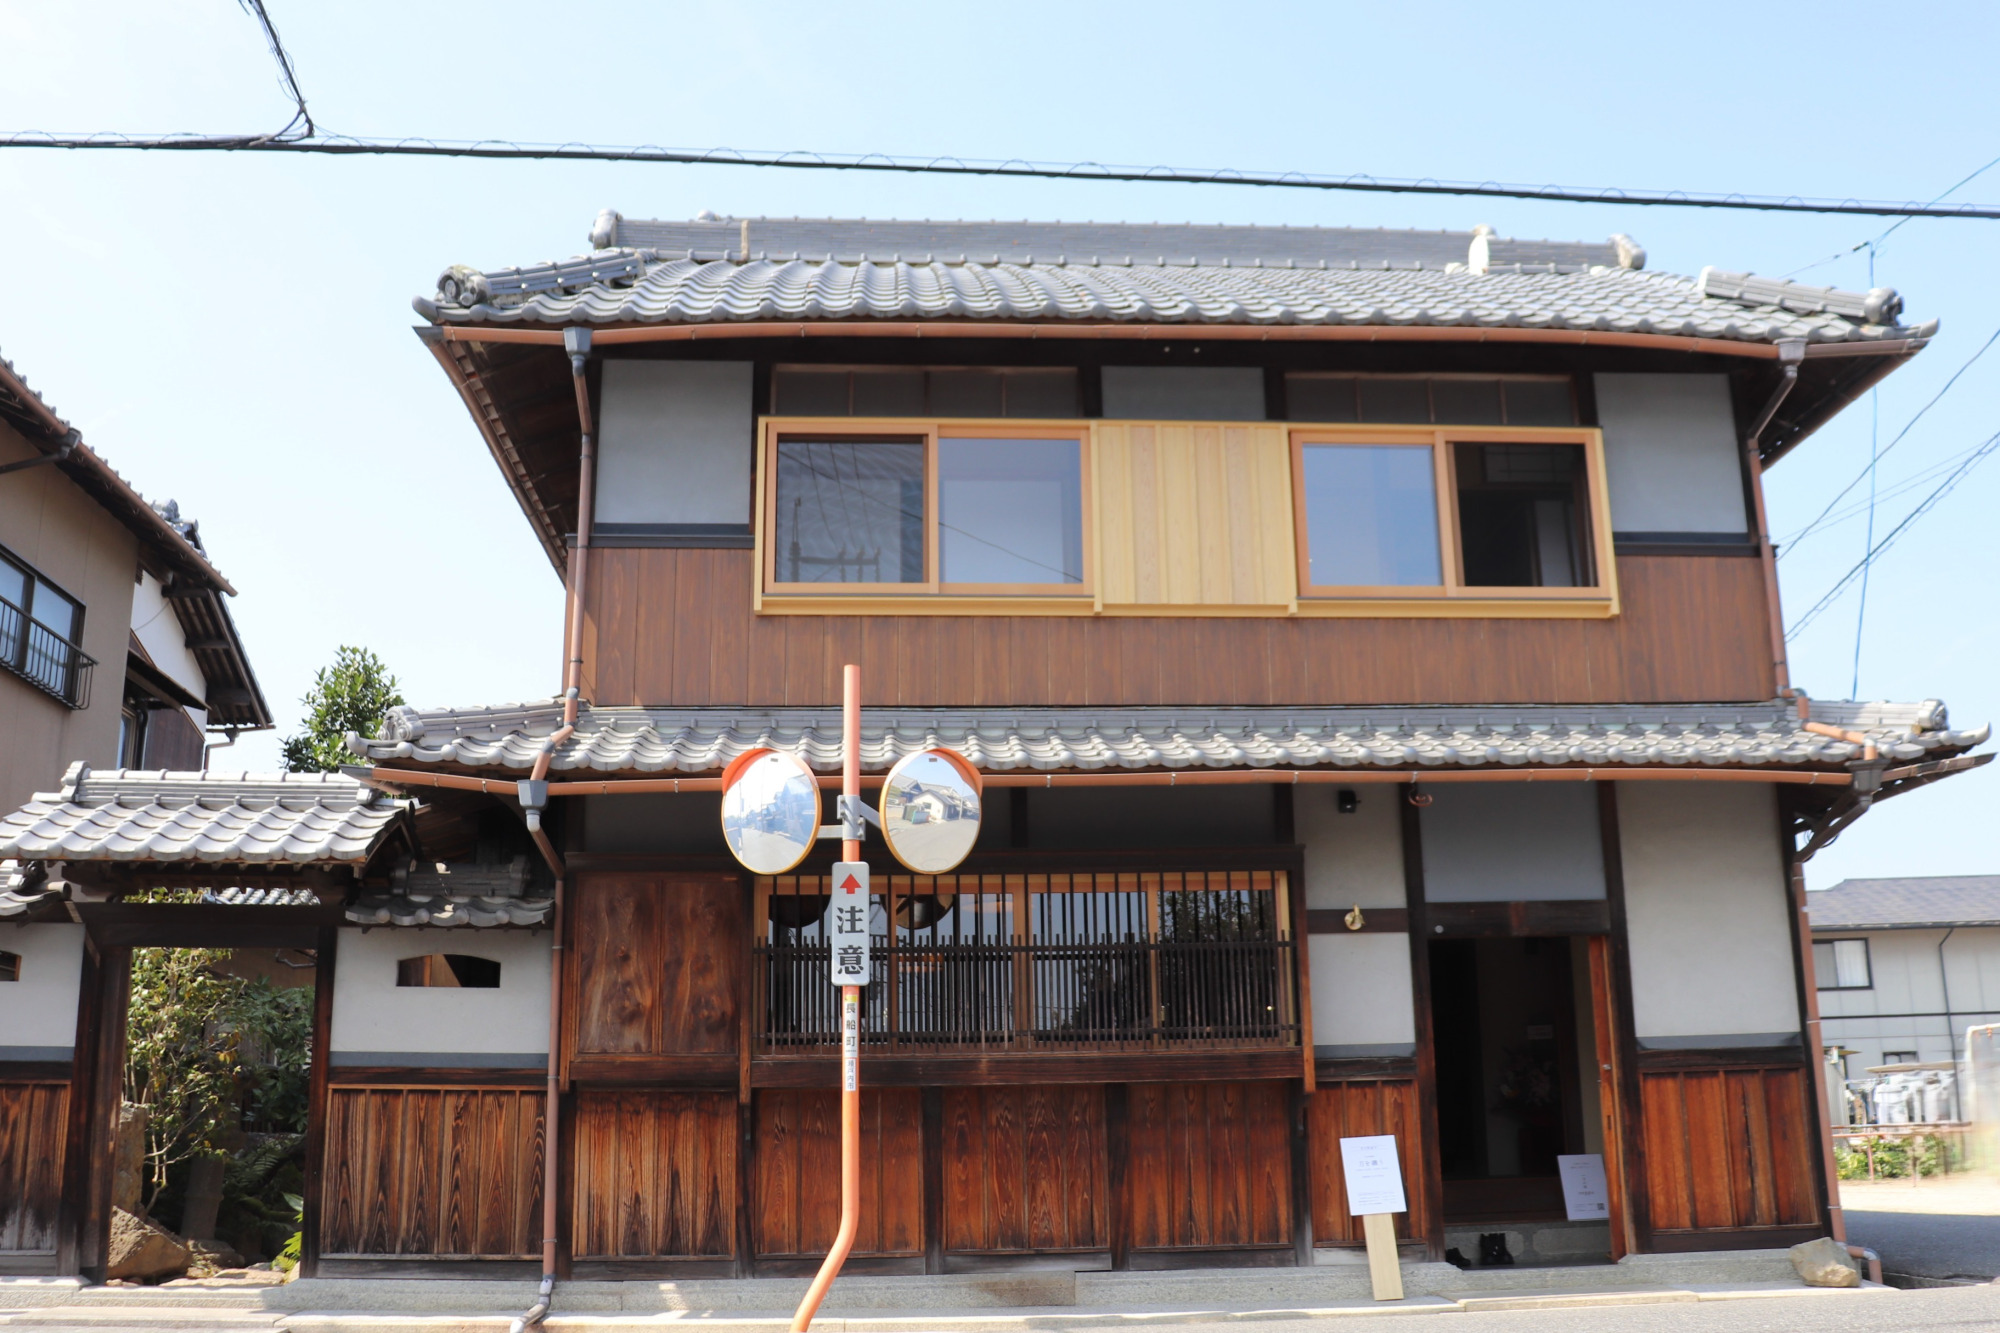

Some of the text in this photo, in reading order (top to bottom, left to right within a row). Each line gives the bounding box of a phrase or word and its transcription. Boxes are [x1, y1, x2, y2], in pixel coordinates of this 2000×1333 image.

[837, 905, 865, 975] 注意
[846, 1002, 856, 1047] 長船町
